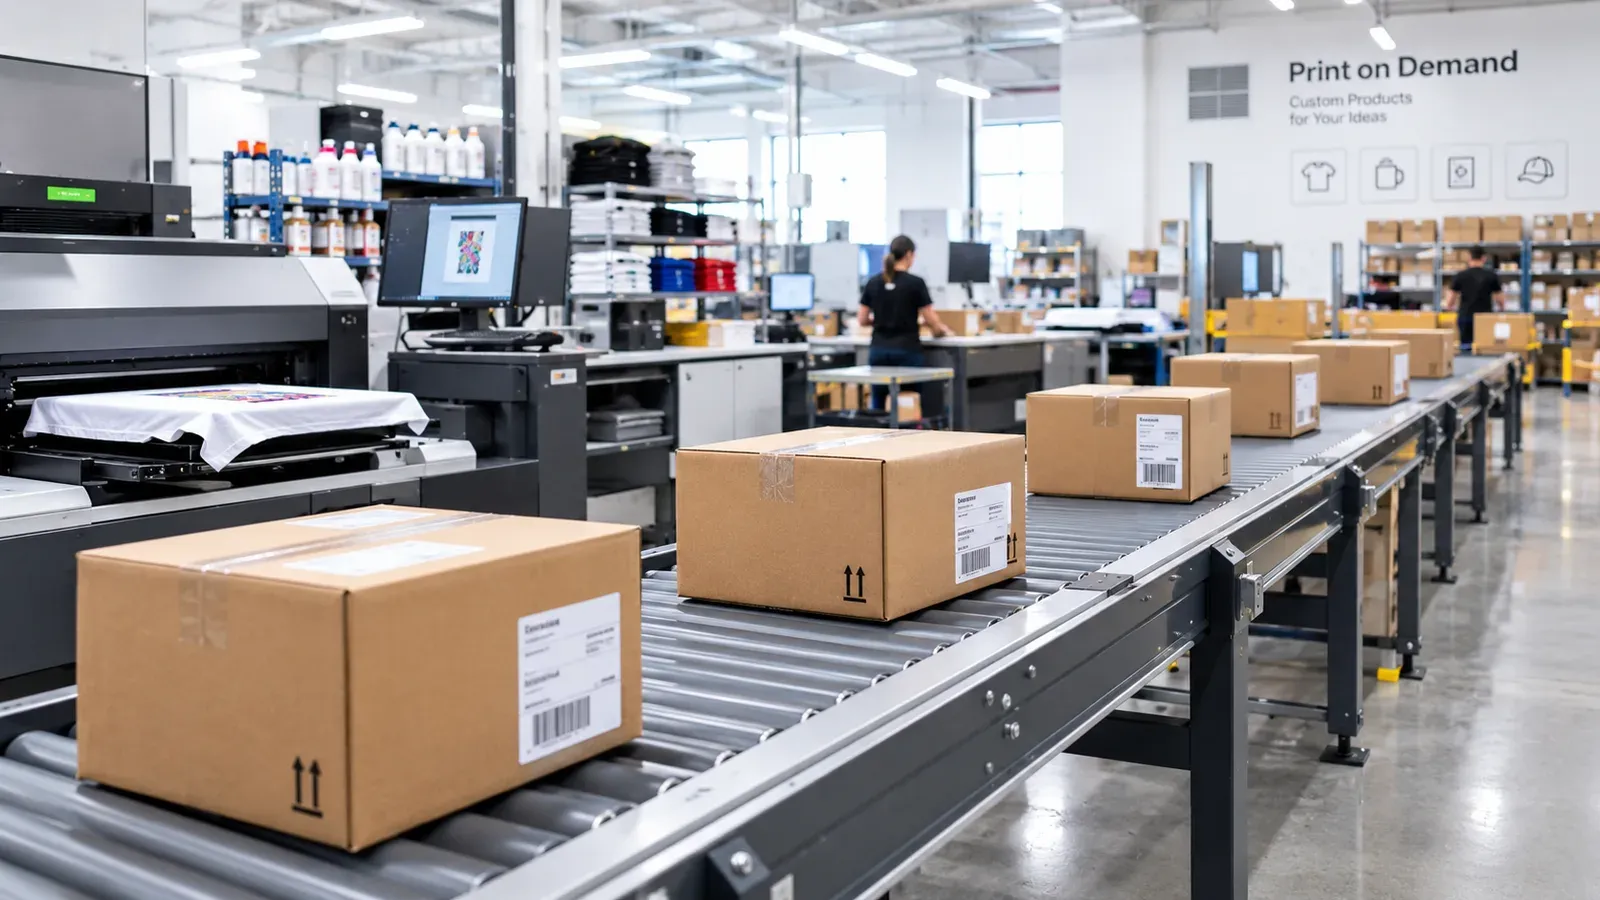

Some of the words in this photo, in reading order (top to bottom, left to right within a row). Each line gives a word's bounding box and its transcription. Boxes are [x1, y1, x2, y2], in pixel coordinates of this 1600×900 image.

[1289, 60, 1351, 83] Print
[1357, 63, 1390, 79] on
[1398, 49, 1518, 77] Demand
[1289, 95, 1344, 108] Custom
[1348, 92, 1413, 106] Products
[1289, 113, 1309, 125] for
[1312, 111, 1344, 124] Your
[1349, 111, 1387, 123] Ideas
